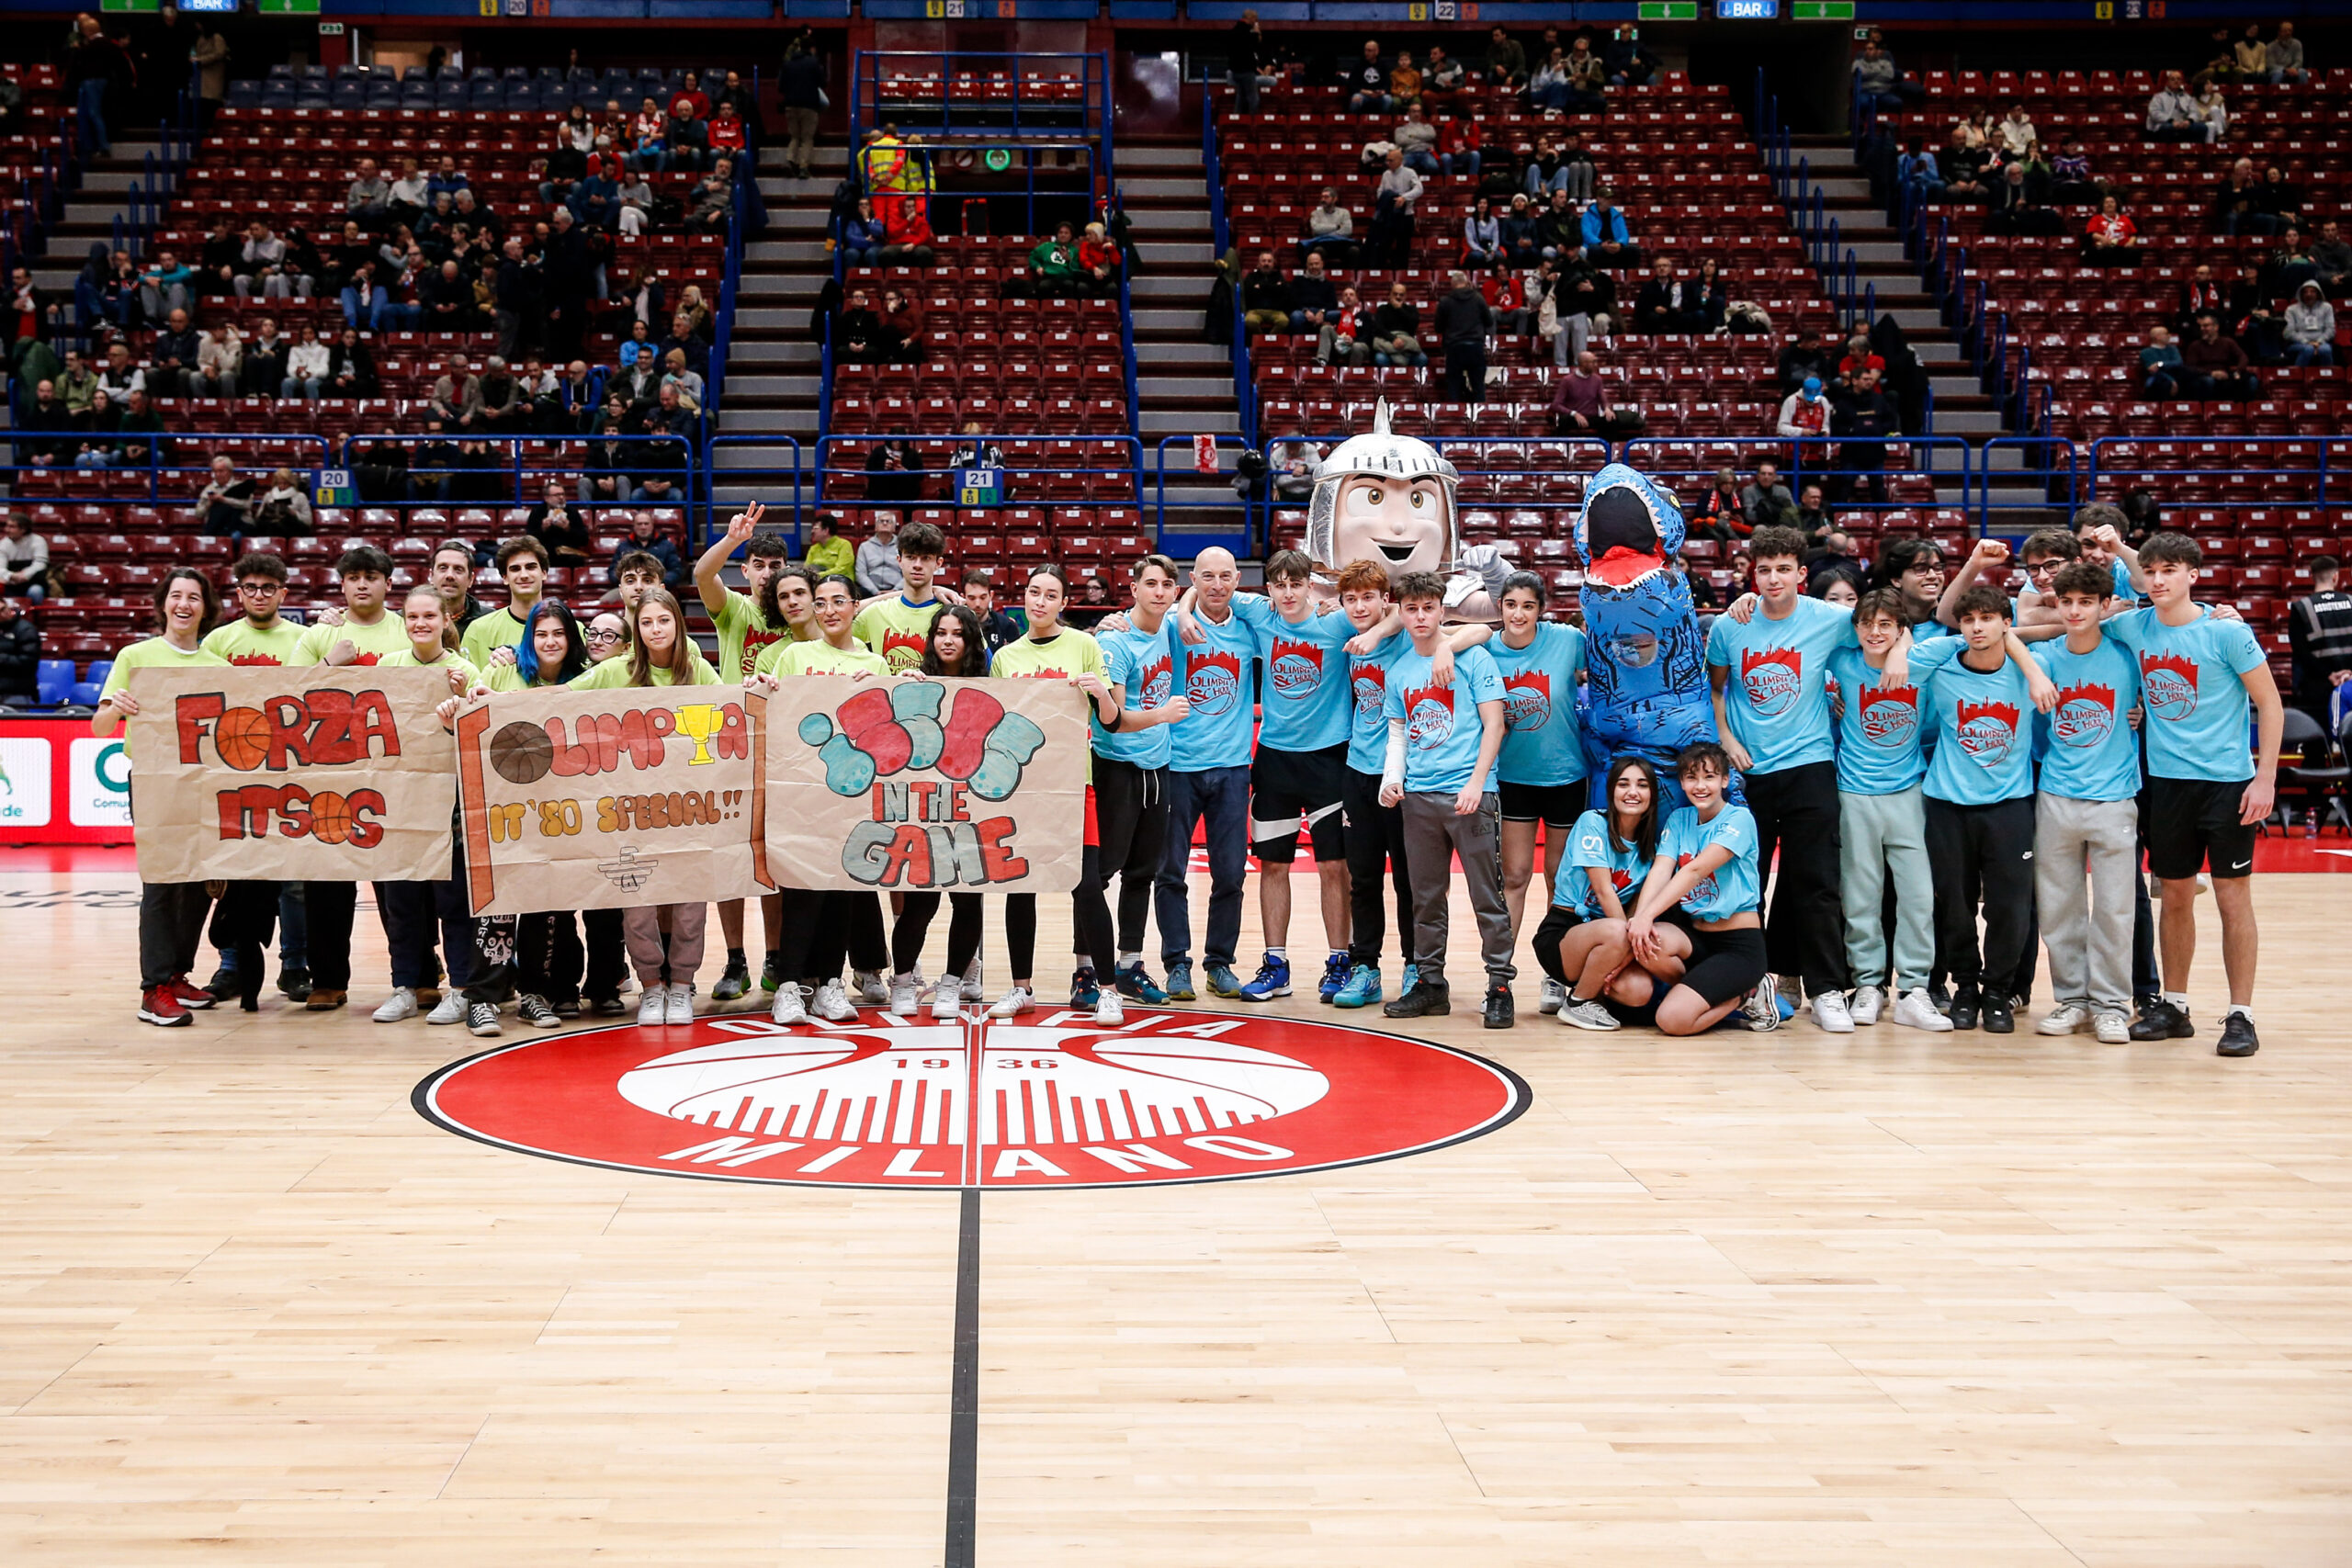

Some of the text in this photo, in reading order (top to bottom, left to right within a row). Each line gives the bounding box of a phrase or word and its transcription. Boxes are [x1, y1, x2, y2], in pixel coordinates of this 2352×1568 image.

[510, 1, 525, 12] 20
[948, 4, 964, 14] 21
[1439, 6, 1453, 16] 22
[1733, 3, 1762, 17] BAR
[324, 472, 344, 485] 20
[970, 473, 987, 485] 21
[872, 782, 970, 822] IN THE
[841, 816, 1029, 887] GAME
[890, 1058, 1058, 1069] 19 36
[657, 1135, 1294, 1179] MILANO
